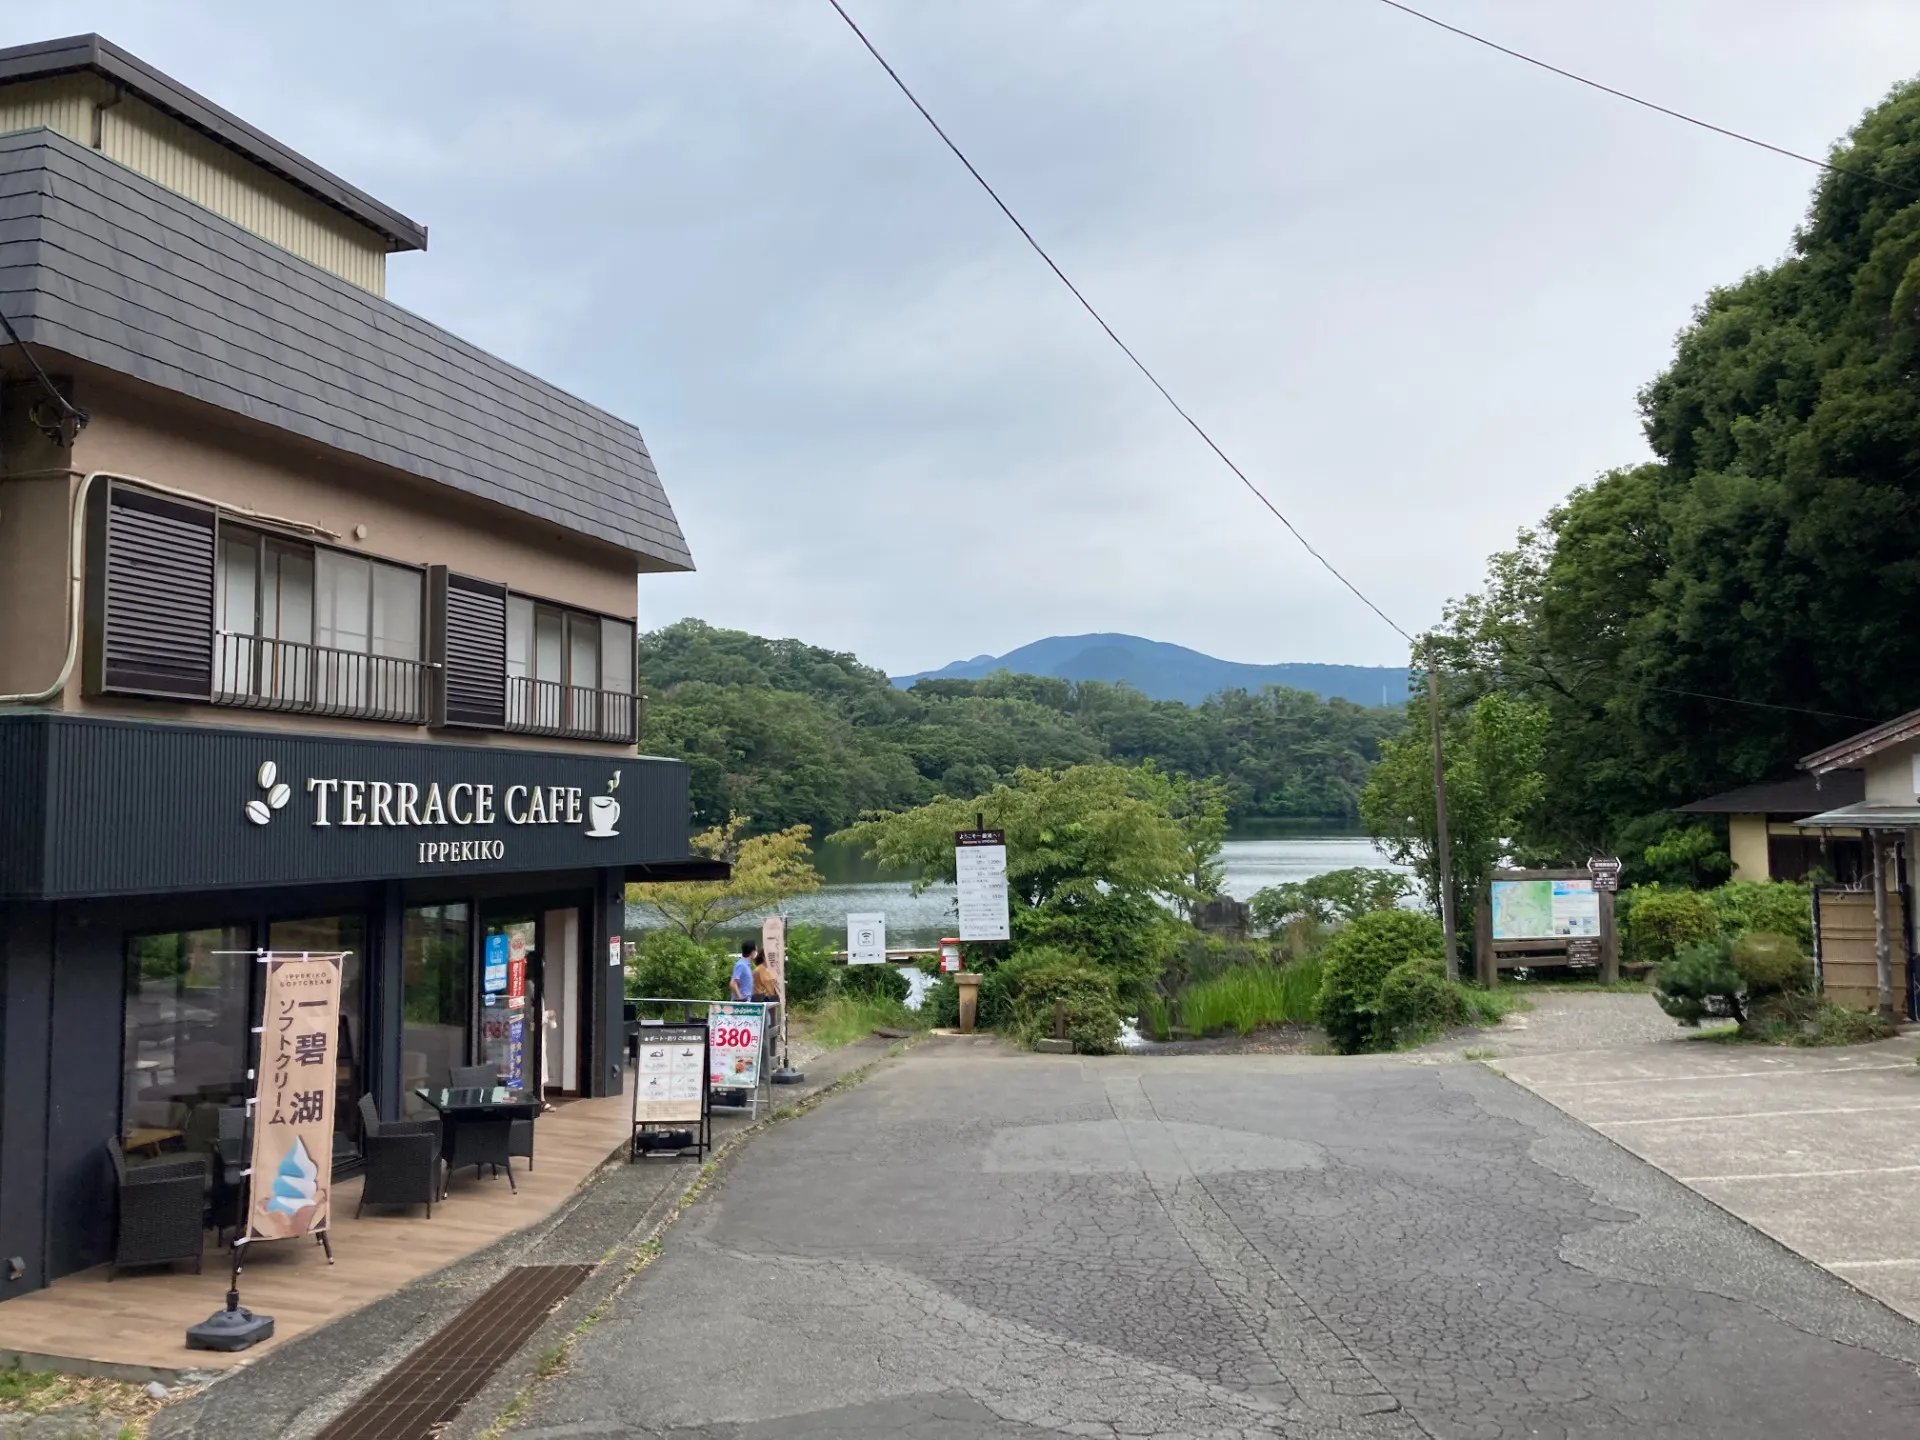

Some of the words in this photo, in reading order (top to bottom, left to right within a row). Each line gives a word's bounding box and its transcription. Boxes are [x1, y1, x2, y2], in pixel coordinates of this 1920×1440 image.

[307, 778, 495, 826] TERRACE
[504, 785, 583, 825] CAFE
[419, 839, 504, 864] IPPEKIKO
[716, 1027, 751, 1048] 380
[268, 999, 296, 1126] ソフトクリーム
[289, 998, 328, 1126] 一碧湖
